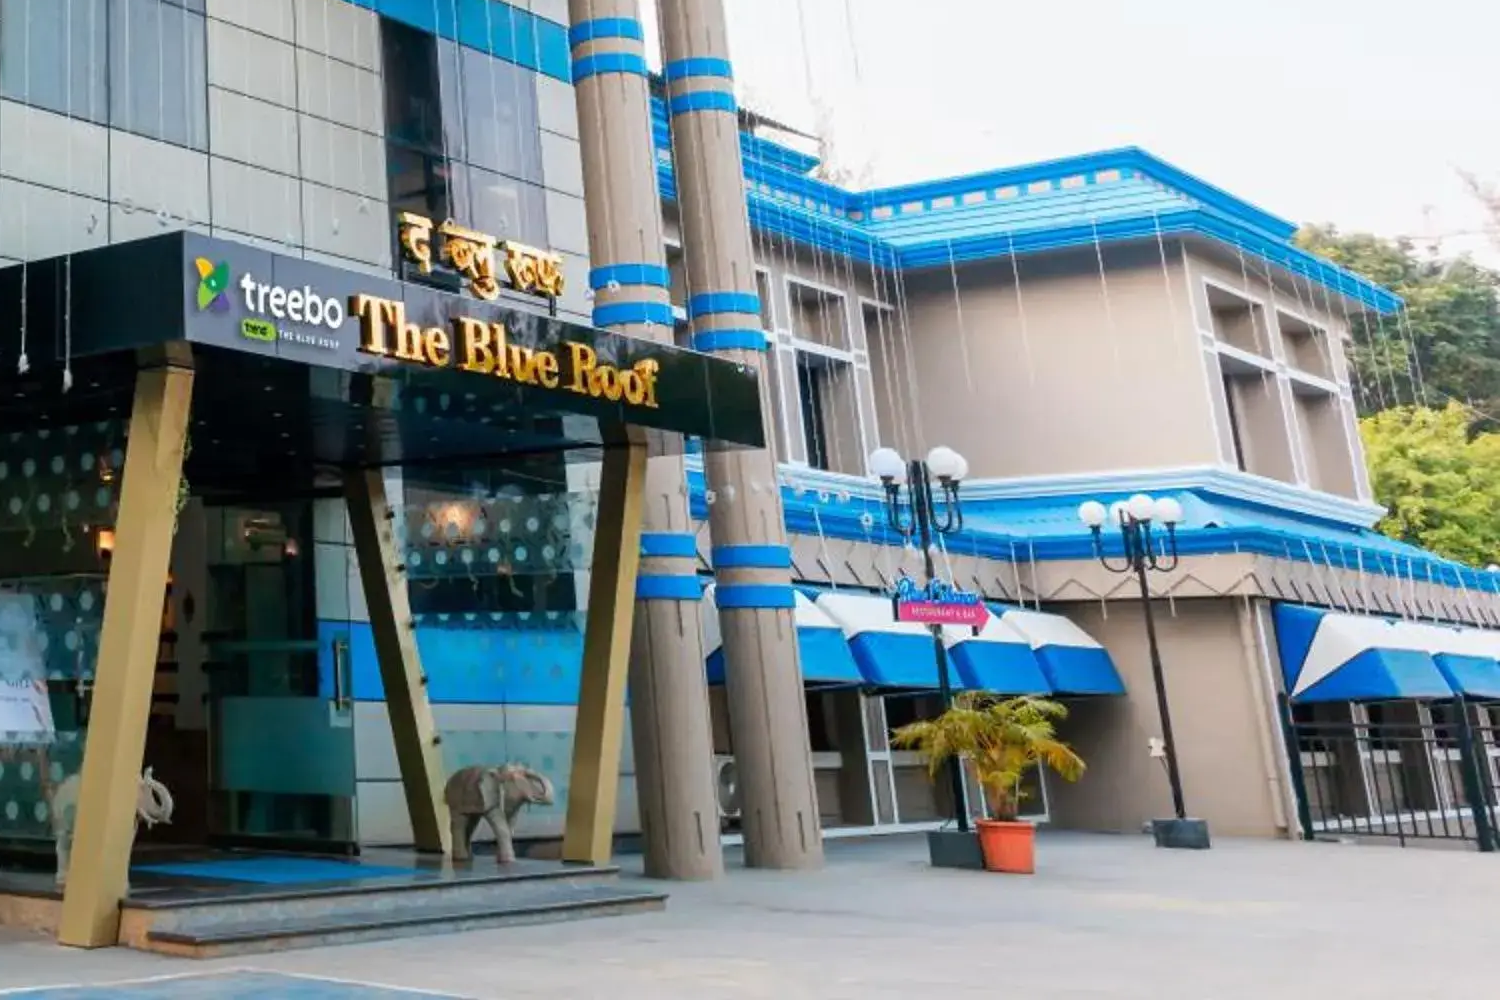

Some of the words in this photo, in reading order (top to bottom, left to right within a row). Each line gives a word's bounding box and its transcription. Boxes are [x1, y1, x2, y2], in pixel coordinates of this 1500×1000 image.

[399, 211, 433, 274] द
[240, 271, 344, 330] treebo
[352, 292, 450, 367] The
[455, 315, 560, 389] Blue
[561, 340, 659, 409] Roof
